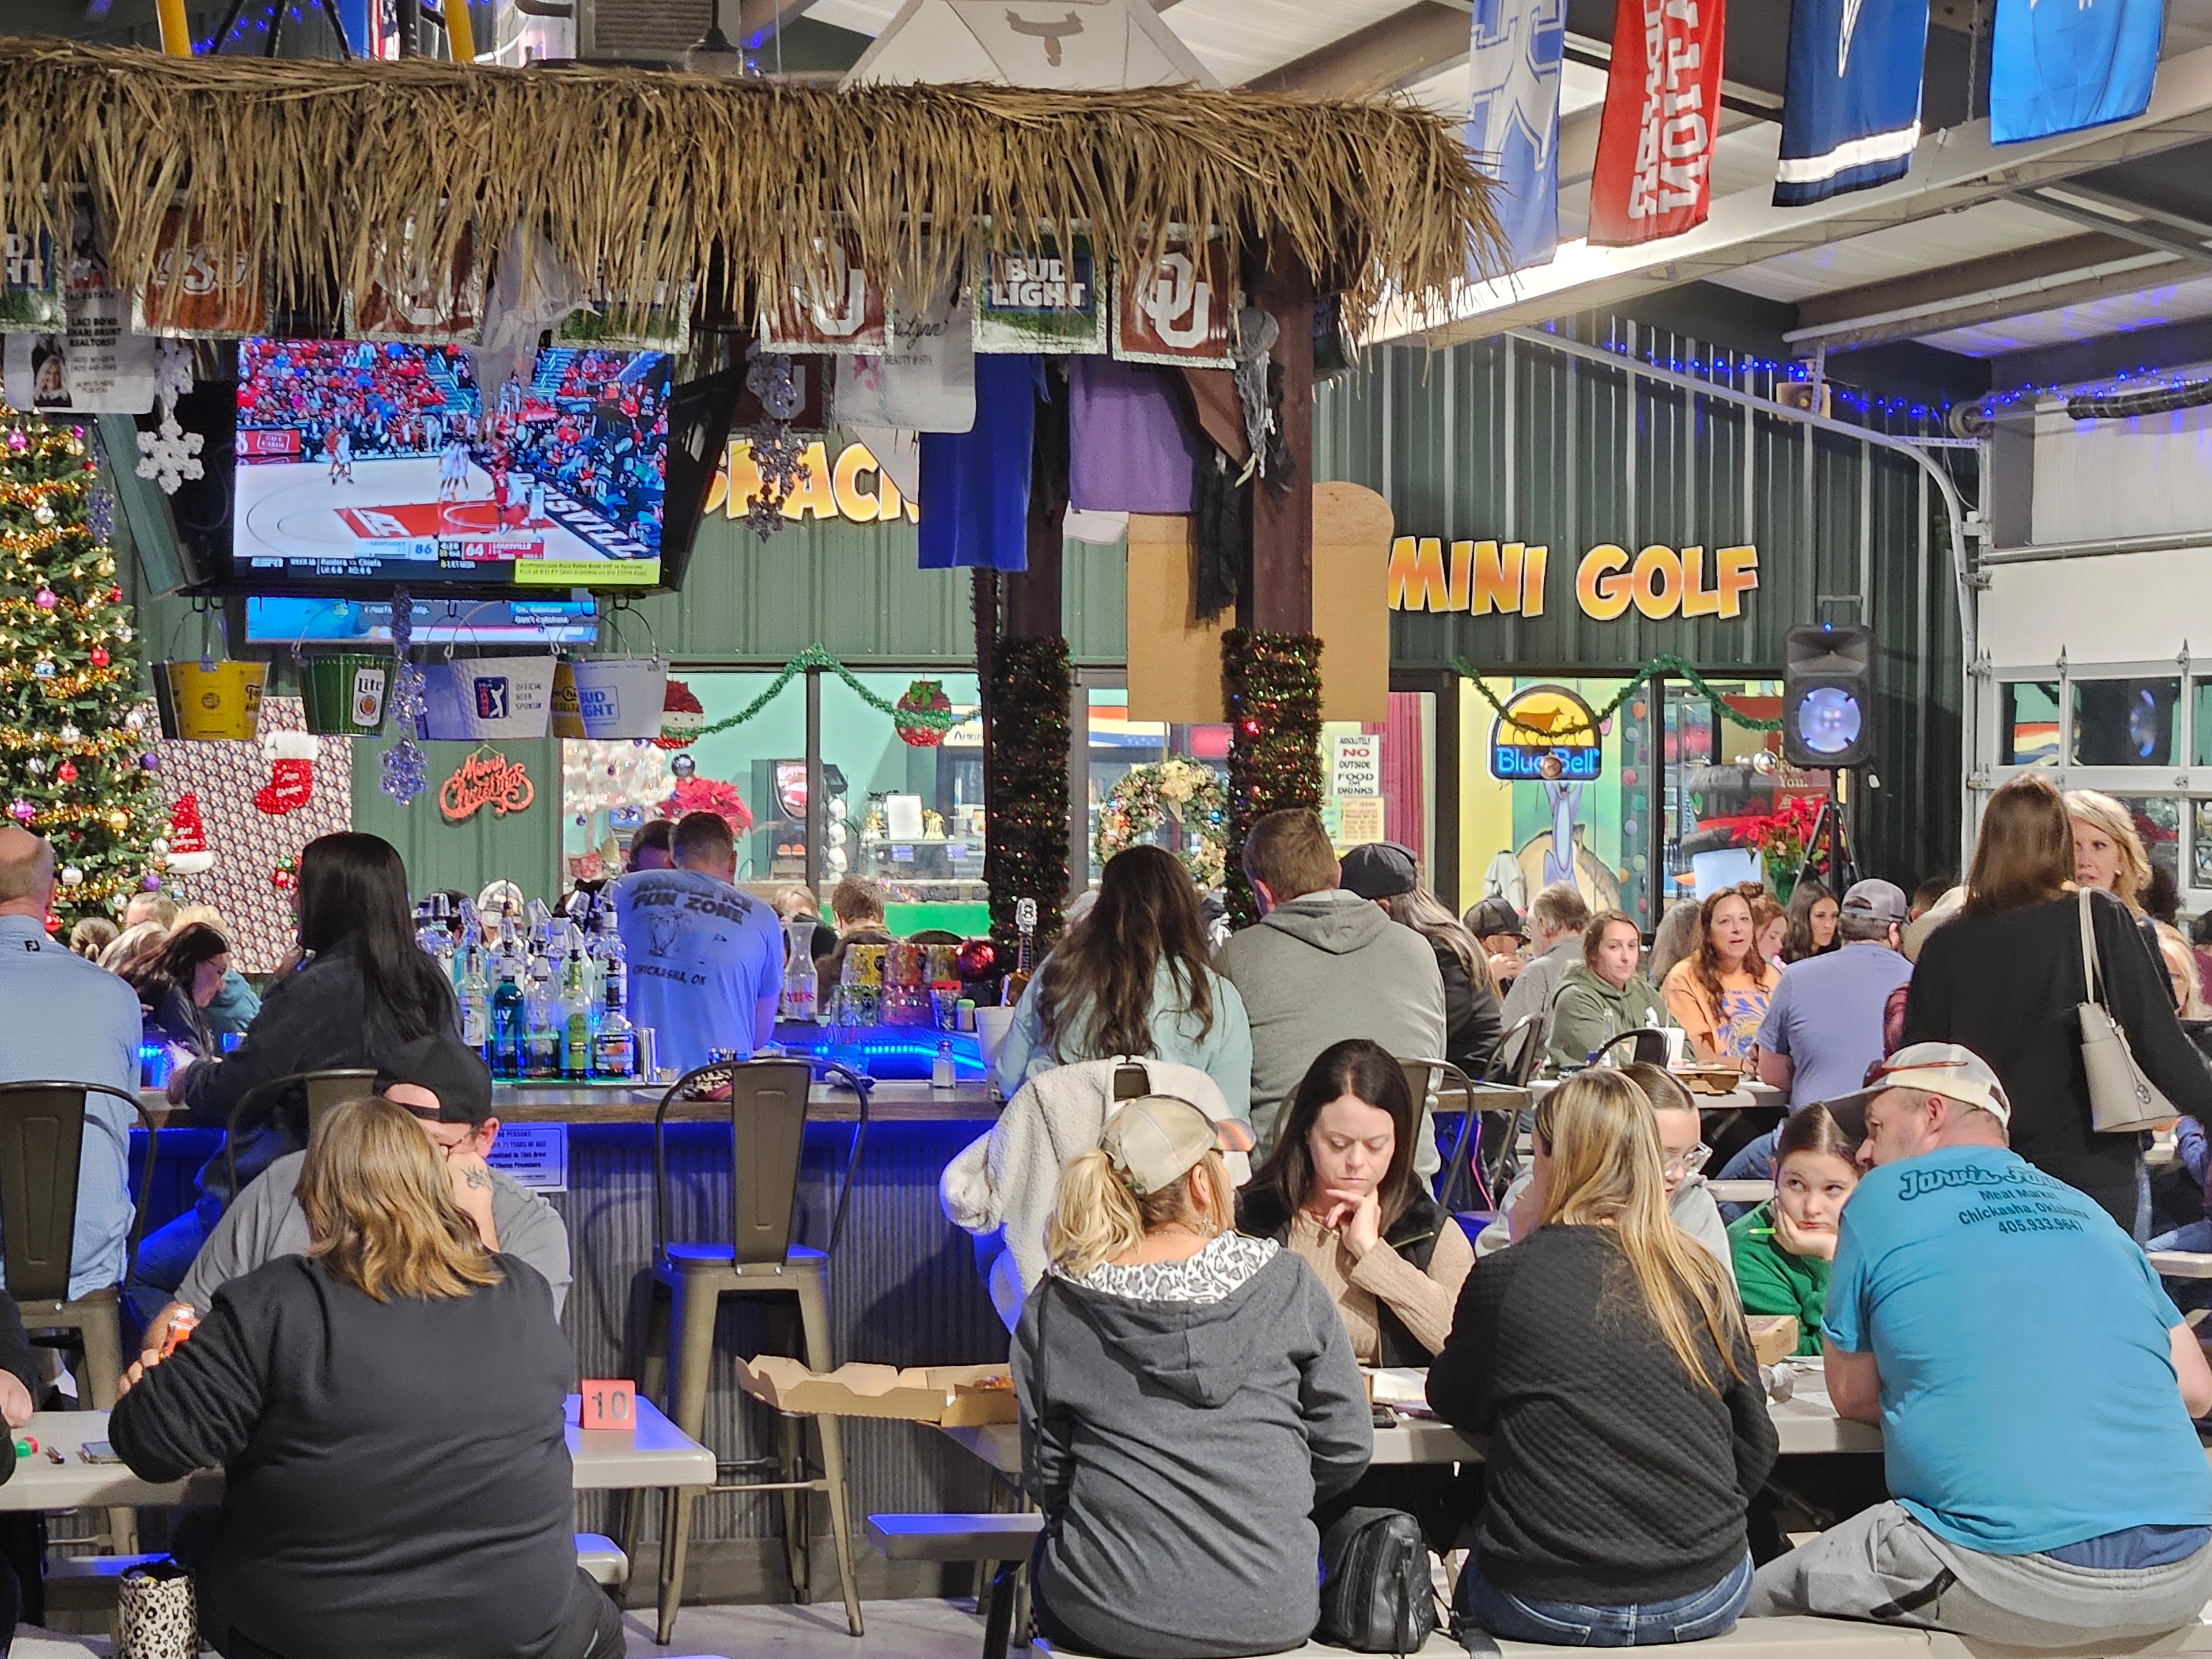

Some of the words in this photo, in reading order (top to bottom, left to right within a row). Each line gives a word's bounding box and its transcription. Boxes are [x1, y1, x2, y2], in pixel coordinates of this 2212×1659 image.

[1005, 259, 1065, 282] BUD
[992, 282, 1086, 306] LIGHT
[1138, 252, 1210, 348] OU
[415, 543, 432, 554] 86
[466, 543, 484, 556] 64
[1388, 536, 1548, 618] MINI
[1576, 544, 1758, 621] GOLF
[358, 677, 382, 694] Lite
[584, 704, 614, 718] GHT
[1343, 749, 1370, 757] NO
[1497, 747, 1545, 774] Blue
[1552, 747, 1600, 774] Bell
[1339, 761, 1370, 769] OUTSIDE
[1778, 775, 1809, 788] You.
[1338, 787, 1374, 795] DRINKS
[684, 896, 743, 926] ZONE
[24, 940, 40, 952] FJ
[691, 974, 706, 985] OK
[1899, 1164, 2002, 1200] Jarvis
[1979, 1190, 2016, 1200] Meat
[2016, 1189, 2060, 1200] Market
[1959, 1203, 2037, 1225] Chickasha,
[592, 1391, 628, 1422] 10
